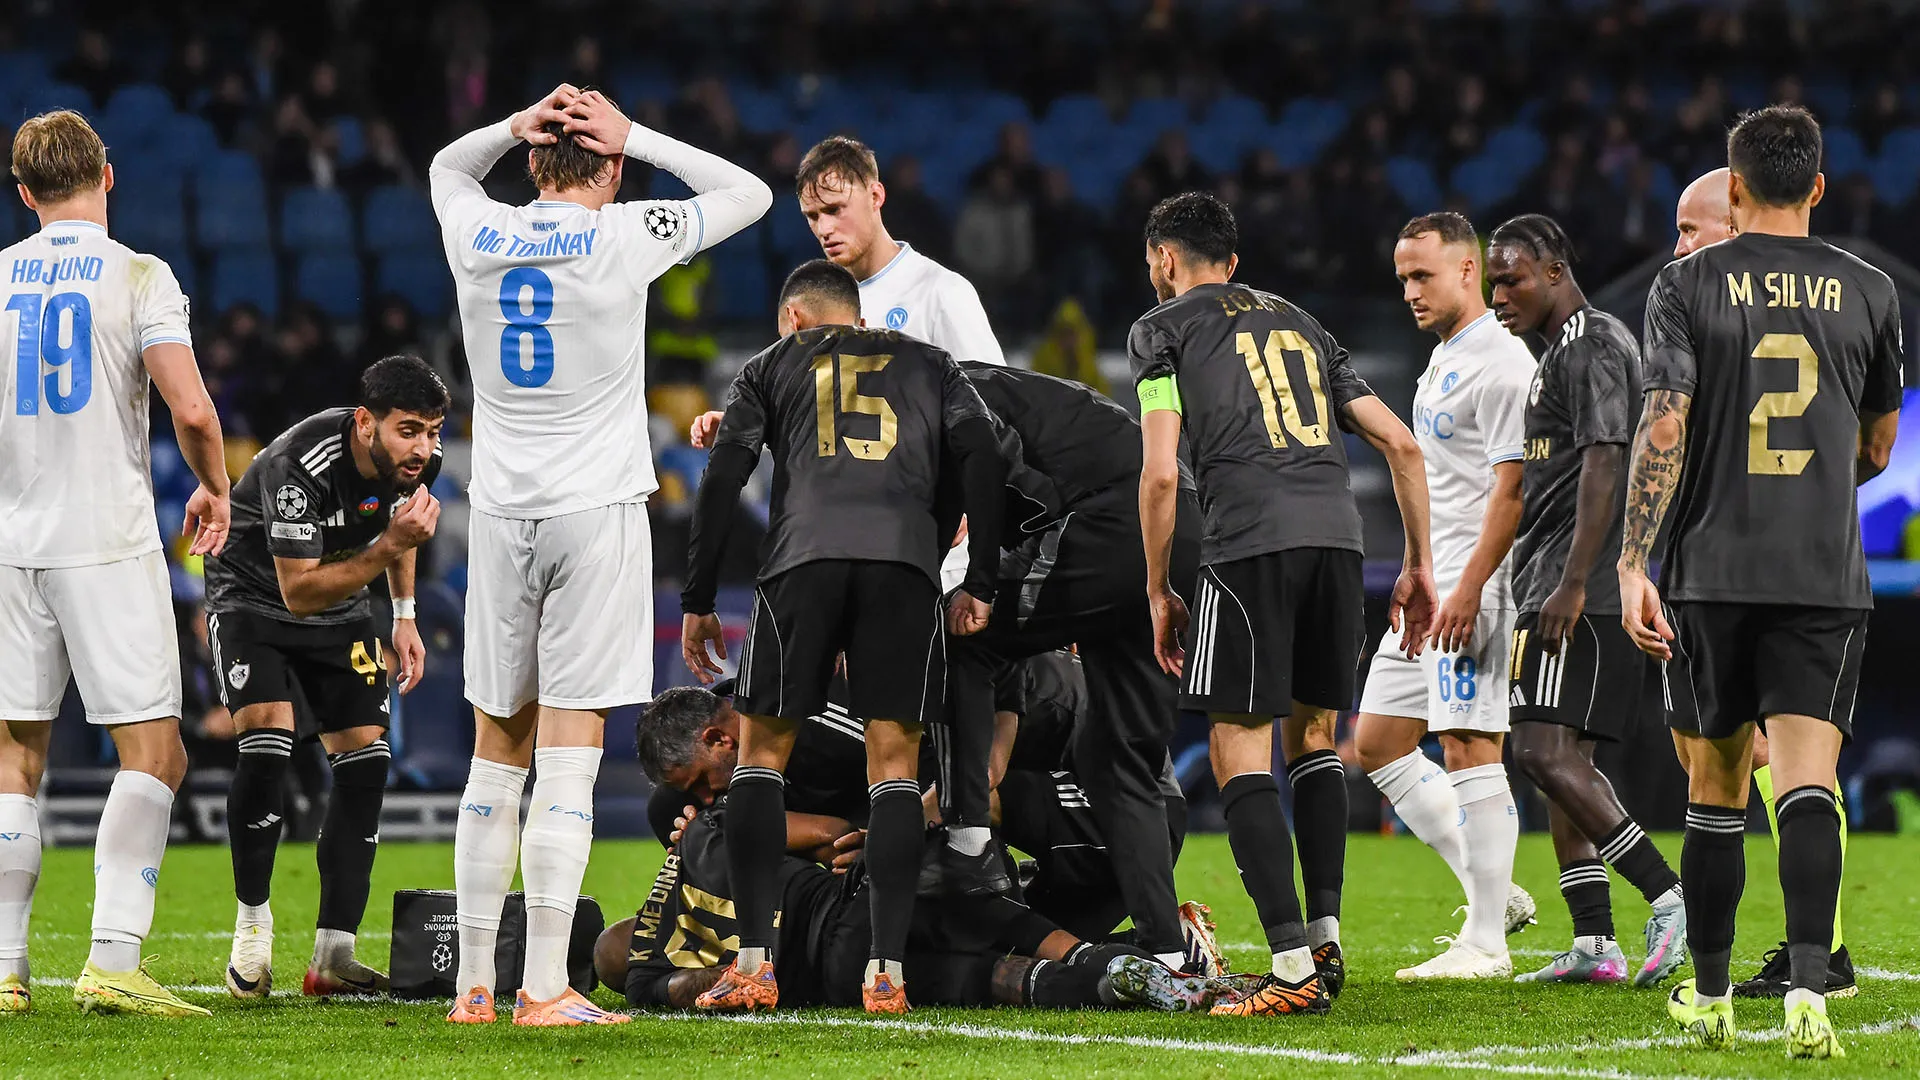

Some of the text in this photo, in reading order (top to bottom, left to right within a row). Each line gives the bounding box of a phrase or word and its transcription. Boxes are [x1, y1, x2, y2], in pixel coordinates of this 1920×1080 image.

[499, 267, 555, 388] 8
[1726, 271, 1842, 312] M SILVA
[5, 292, 92, 416] 19
[808, 353, 898, 461] 15
[1236, 329, 1331, 448] 10
[1748, 333, 1818, 475] 2
[1646, 460, 1674, 478] 1997
[1437, 655, 1476, 702] 68
[1449, 703, 1472, 714] EA7
[628, 853, 682, 962] K MEDINA
